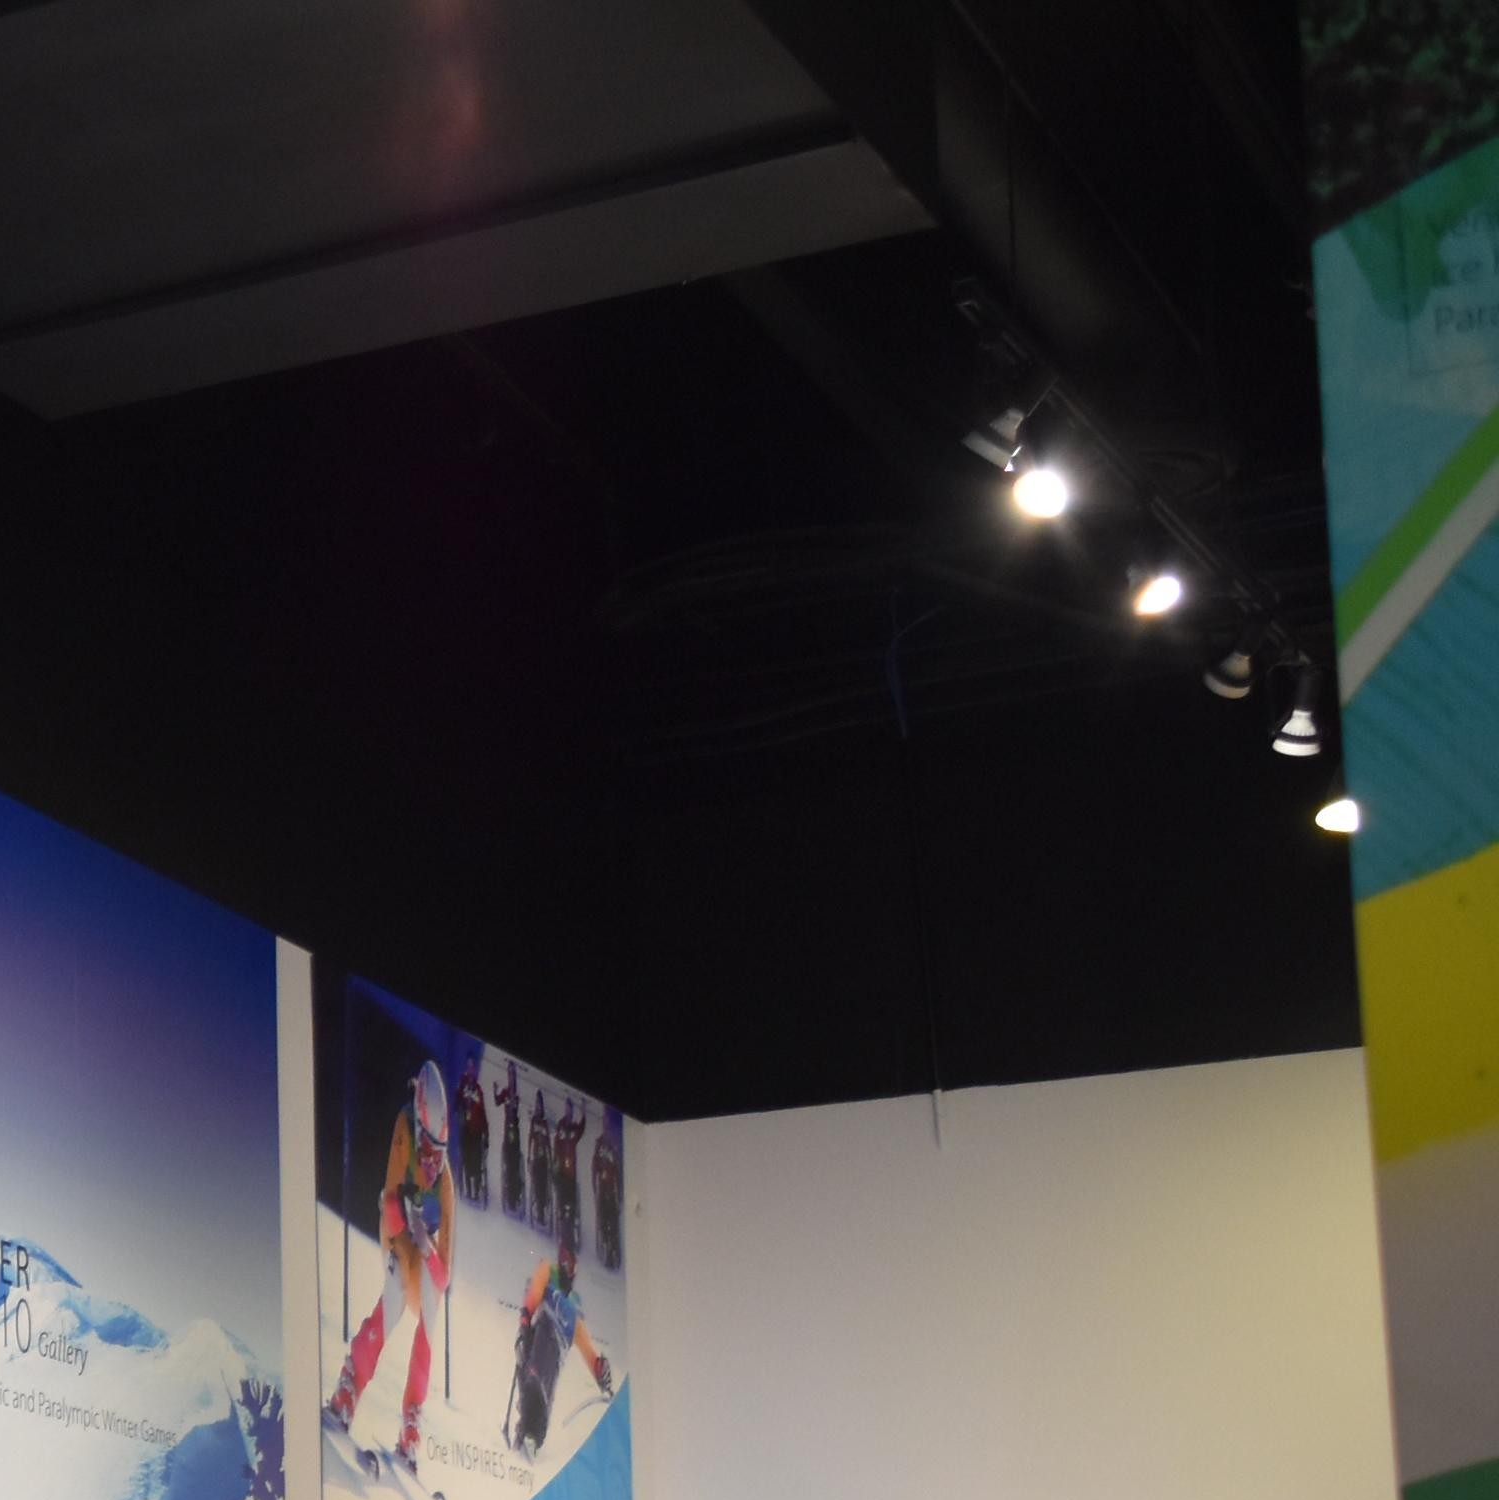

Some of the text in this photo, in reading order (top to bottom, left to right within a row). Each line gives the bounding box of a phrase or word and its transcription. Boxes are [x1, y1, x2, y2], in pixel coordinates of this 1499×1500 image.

[37, 1331, 90, 1376] Gallery
[12, 1388, 35, 1413] and
[38, 1391, 100, 1431] Paralympic
[103, 1409, 139, 1439] Winter
[140, 1419, 177, 1447] Games
[427, 1436, 535, 1493] One INSPIRES many
